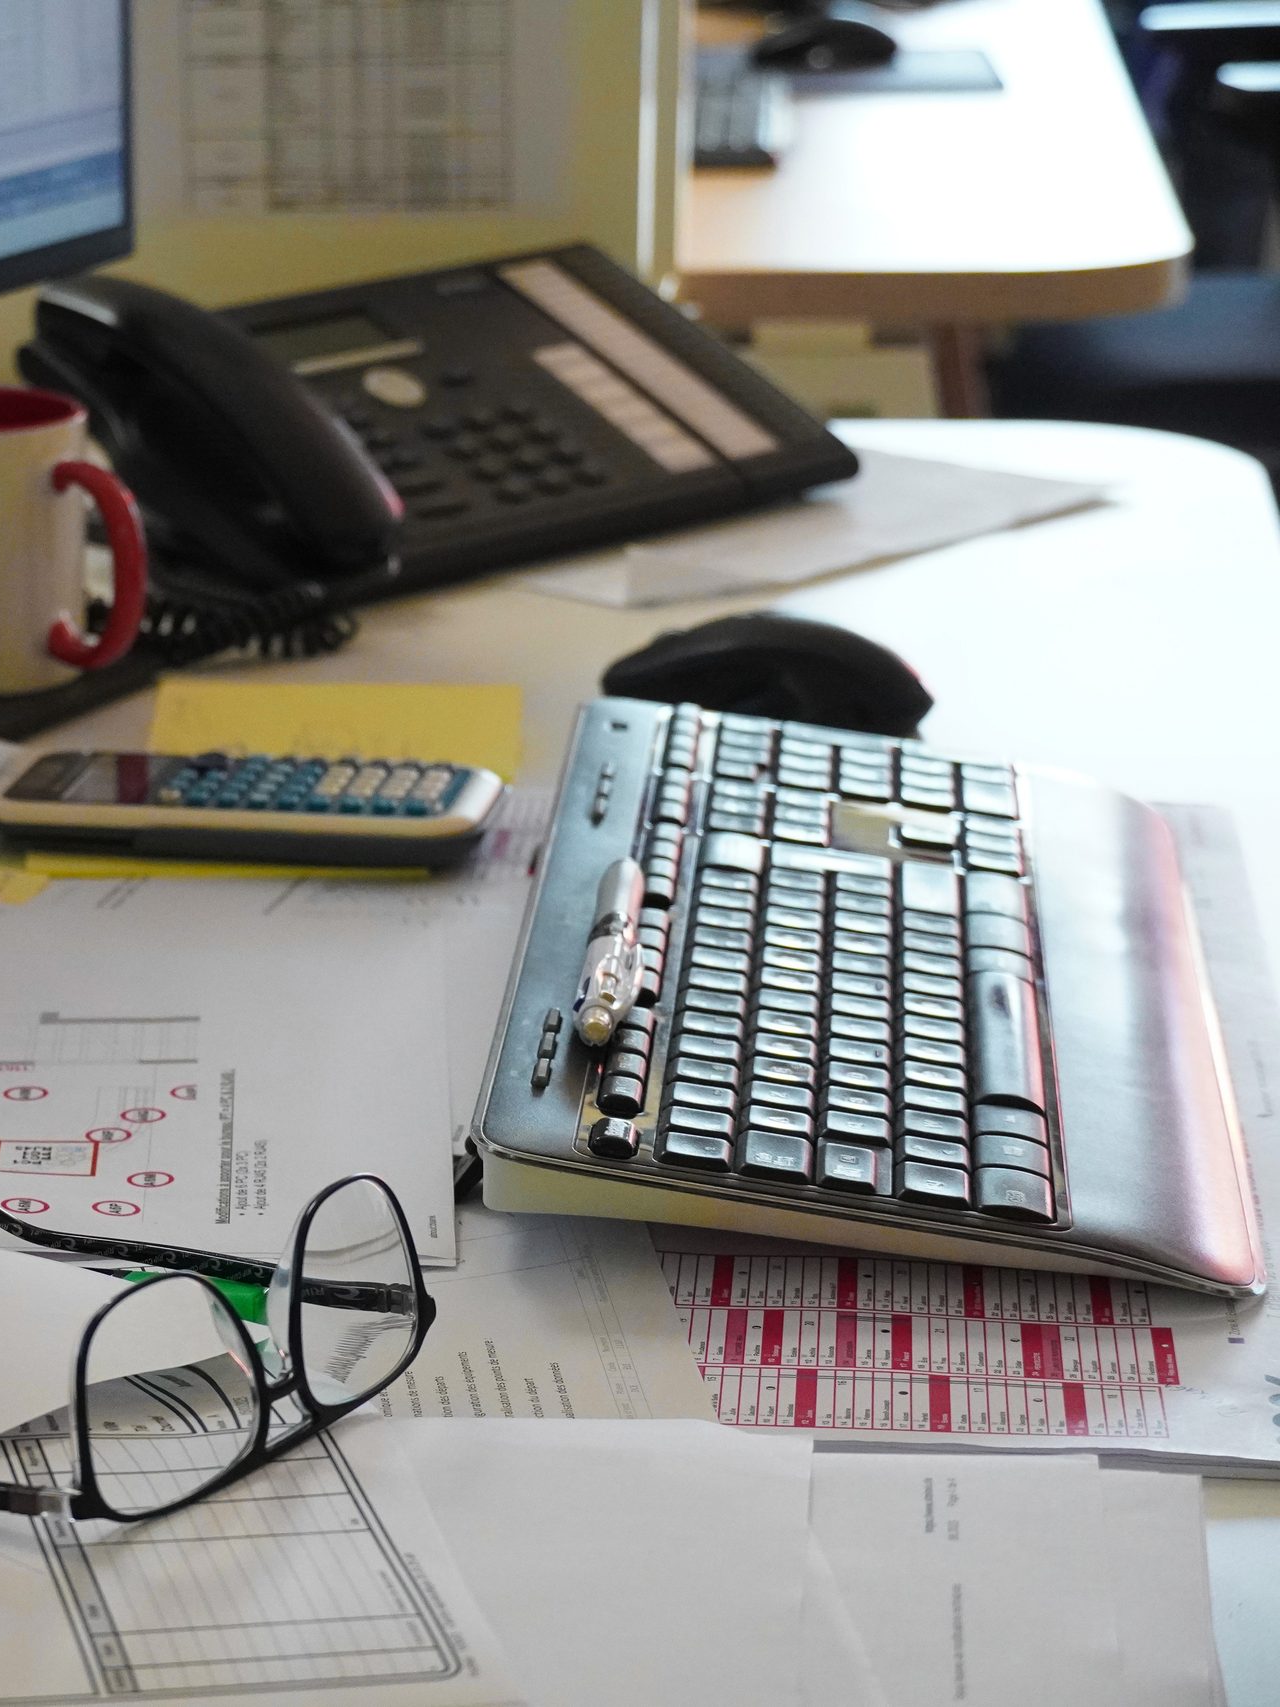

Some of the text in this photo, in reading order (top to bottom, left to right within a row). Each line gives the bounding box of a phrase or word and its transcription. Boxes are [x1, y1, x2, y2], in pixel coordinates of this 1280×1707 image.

[484, 1340, 497, 1358] mesure
[404, 1371, 416, 1390] mesure
[491, 1366, 506, 1381] points
[548, 1362, 564, 1384] données
[465, 1384, 477, 1392] des
[494, 1382, 506, 1391] des
[523, 1378, 538, 1395] départ
[556, 1385, 567, 1393] des
[438, 1396, 450, 1405] des
